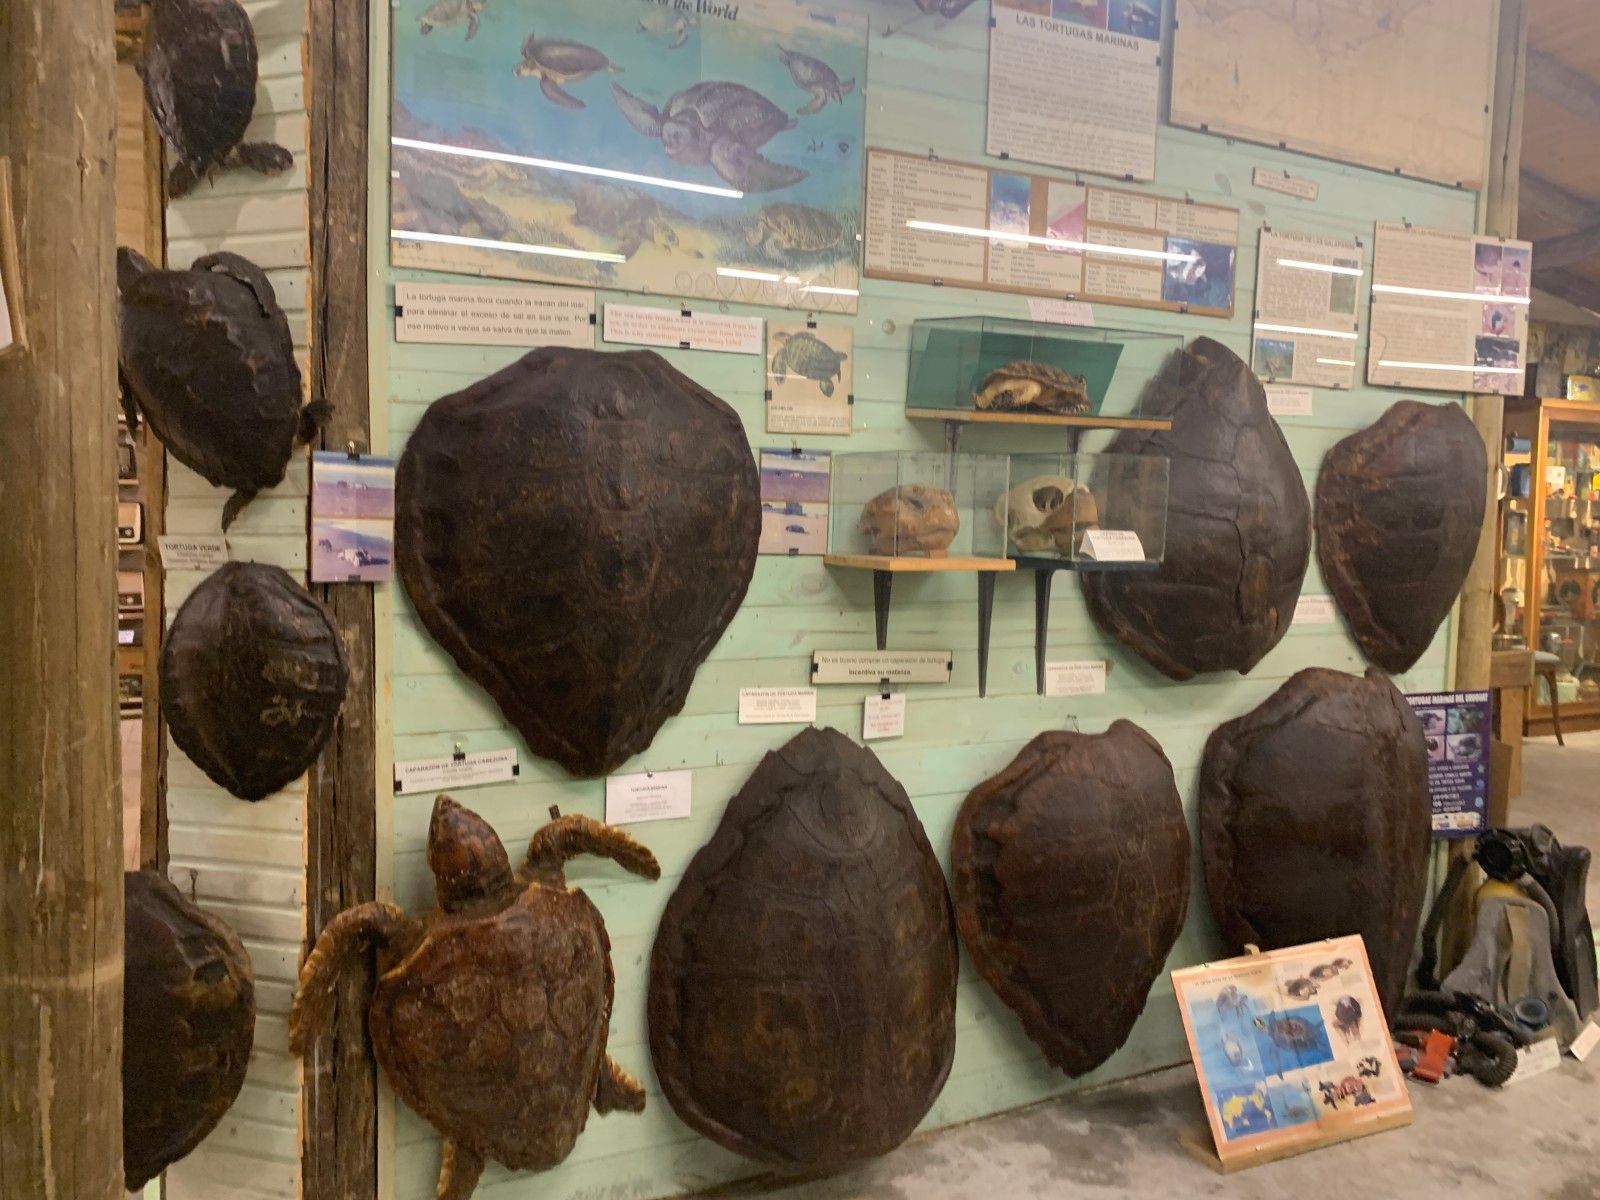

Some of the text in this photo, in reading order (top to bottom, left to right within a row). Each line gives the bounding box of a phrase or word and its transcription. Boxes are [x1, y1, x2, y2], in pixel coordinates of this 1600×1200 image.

[696, 0, 740, 21] World
[1016, 13, 1140, 51] LAS TORTUGAS MARINAS
[406, 292, 417, 301] La
[419, 293, 447, 304] tortuga
[448, 294, 475, 303] marina
[477, 295, 493, 304] llora
[495, 297, 523, 305] cuando
[525, 298, 532, 306] la
[533, 299, 556, 307] sacan
[558, 299, 569, 308] del
[406, 309, 425, 319] para
[427, 308, 458, 317] eliminar
[461, 309, 468, 317] el
[470, 311, 498, 319] exceso
[500, 312, 510, 320] de
[538, 314, 552, 322] sus
[424, 323, 449, 332] motivo
[514, 327, 524, 335] de
[525, 328, 539, 337] que
[165, 543, 221, 553] TORTUGA VERDE
[821, 655, 831, 664] No
[839, 656, 857, 664] bueno
[858, 657, 881, 667] comprar
[919, 656, 926, 664] de
